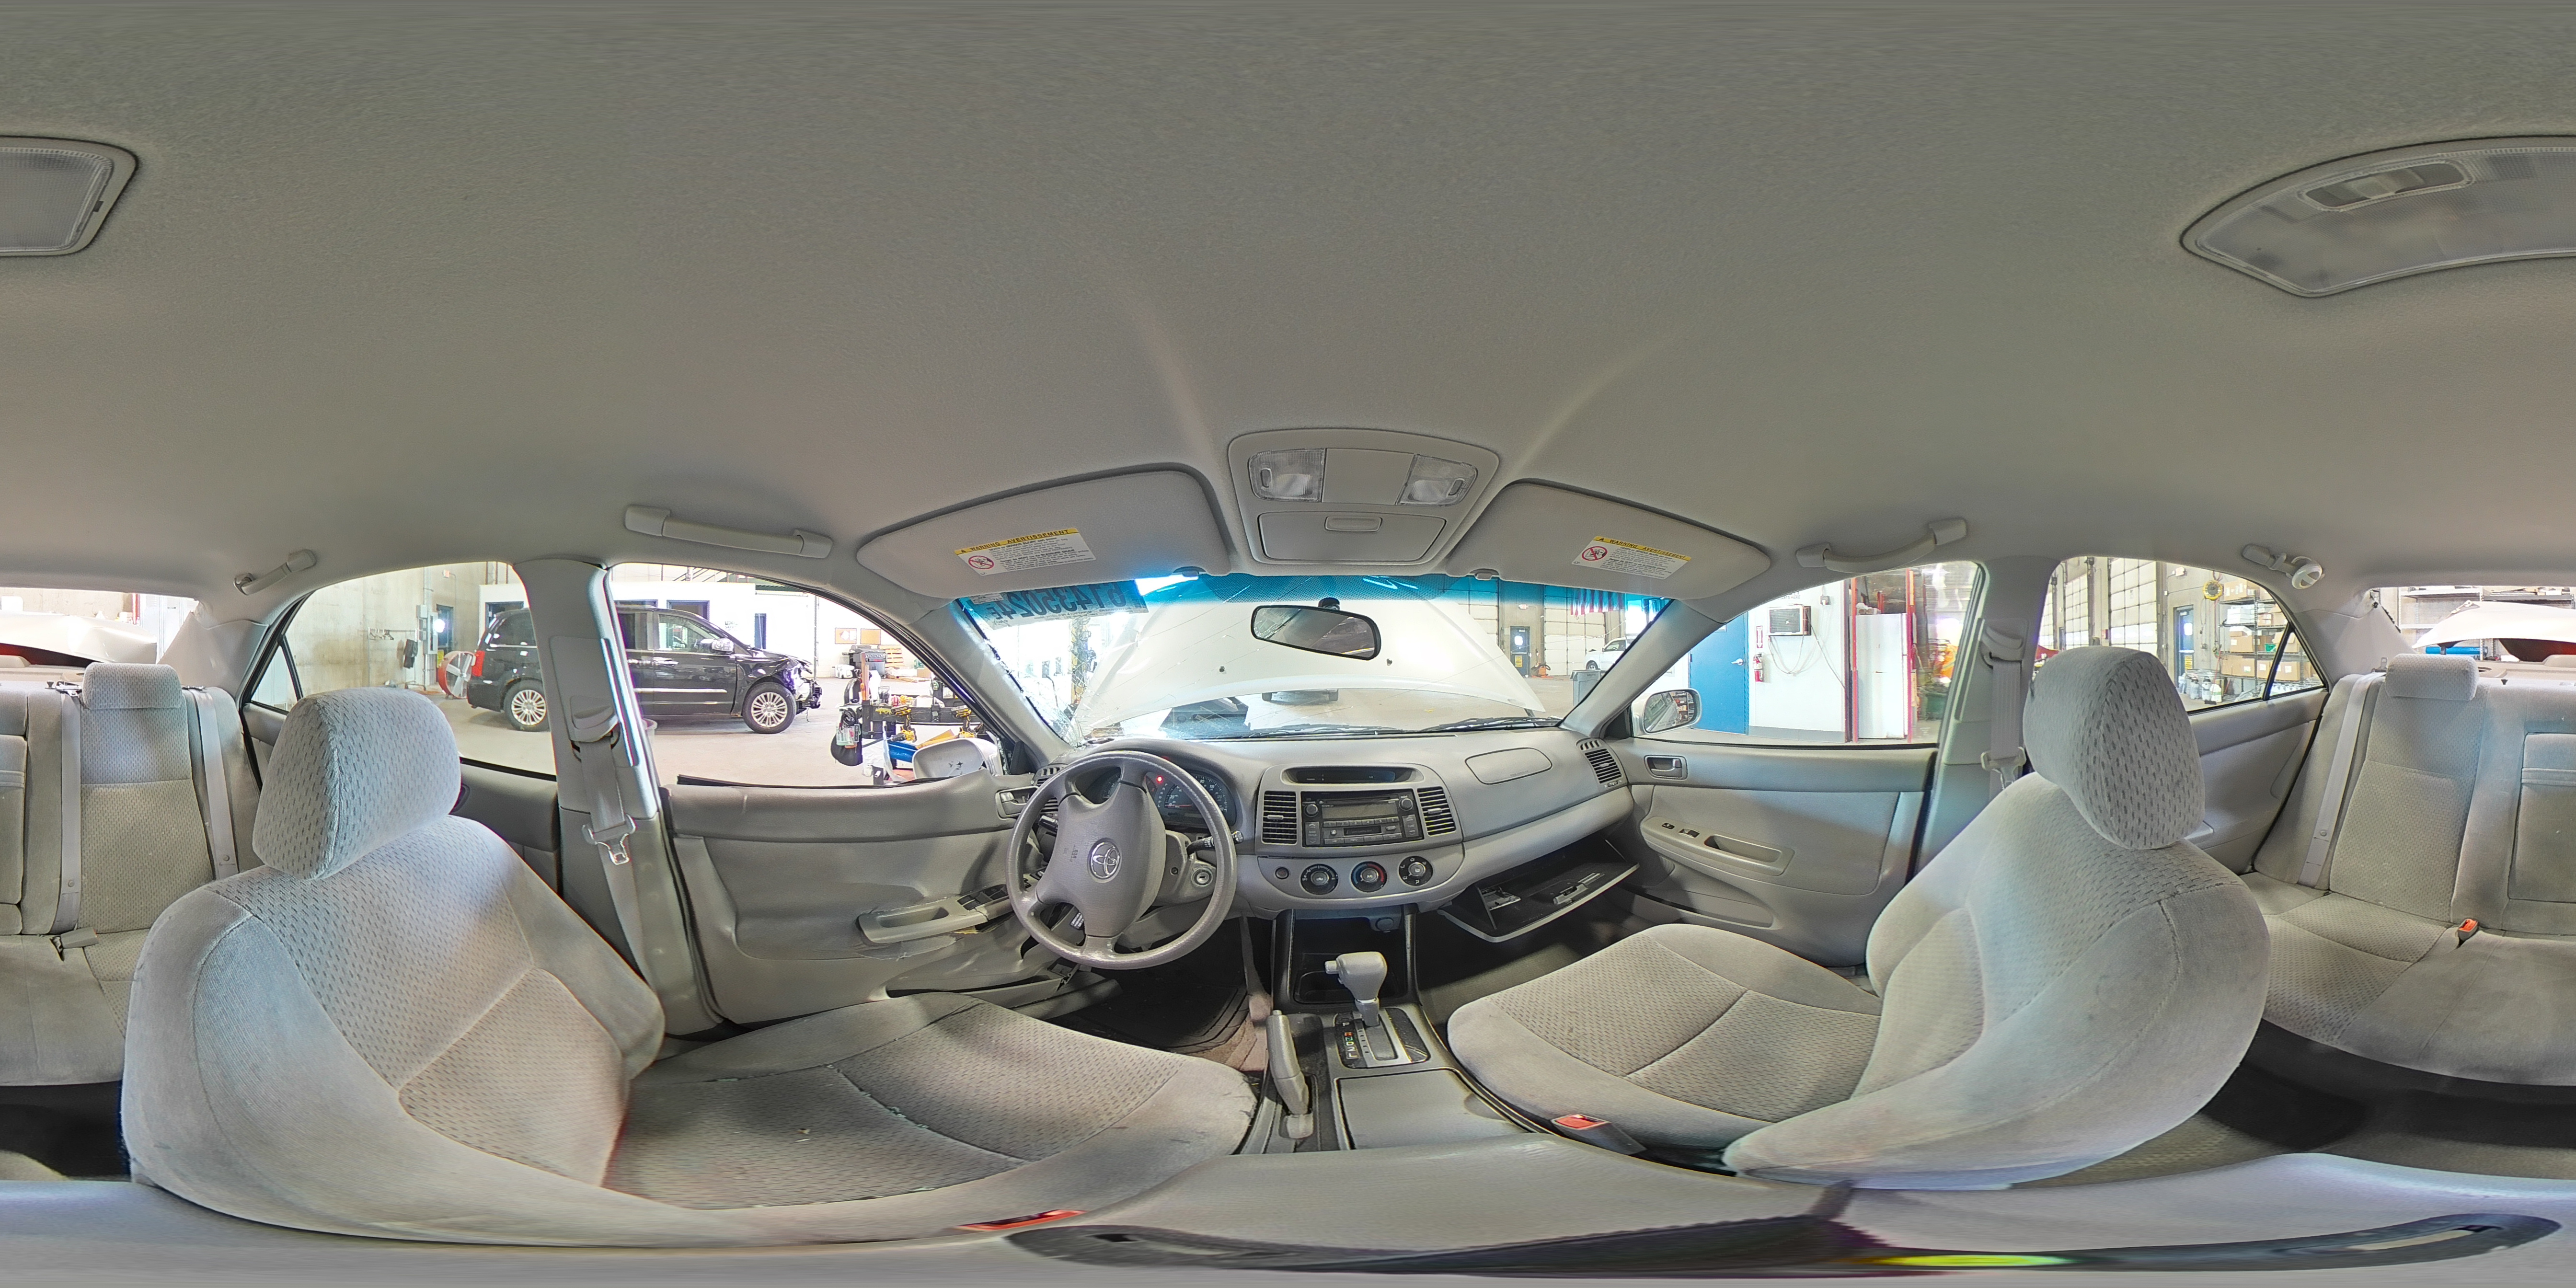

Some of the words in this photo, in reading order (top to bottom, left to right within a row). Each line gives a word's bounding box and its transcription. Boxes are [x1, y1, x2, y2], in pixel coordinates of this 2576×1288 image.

[969, 541, 1000, 551] WARNING
[1007, 529, 1069, 543] AVERTISSEMENT
[1610, 539, 1637, 548] WARNING
[1643, 546, 1686, 560] AVERTISSEMENT
